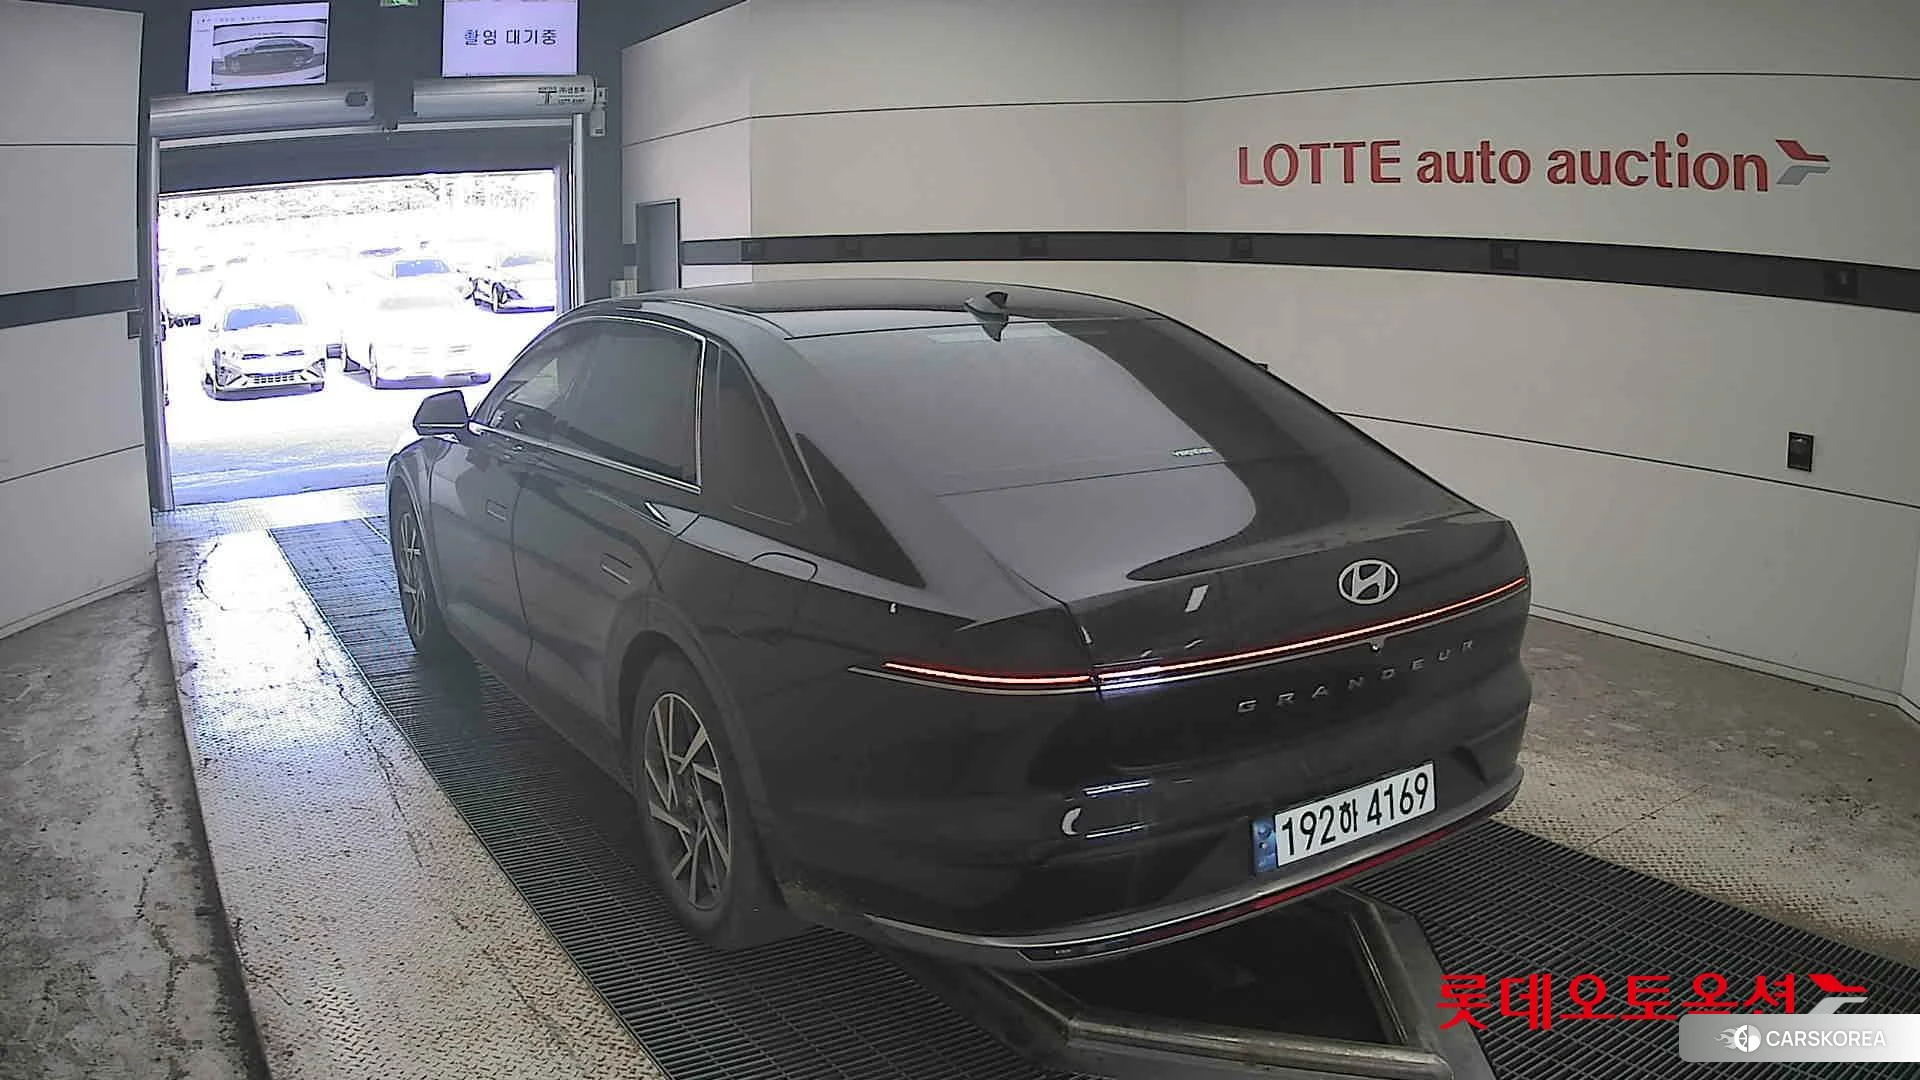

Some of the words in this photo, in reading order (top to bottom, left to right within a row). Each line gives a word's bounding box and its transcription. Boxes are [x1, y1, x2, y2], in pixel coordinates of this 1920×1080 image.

[464, 29, 497, 46] 촬영
[505, 28, 557, 46] 대기중
[1237, 138, 1401, 187] LOTTE
[1416, 139, 1532, 186] auto
[1546, 131, 1770, 193] auction
[1237, 639, 1476, 714] GRANDEUR
[1281, 799, 1359, 857] 192하
[1366, 772, 1429, 827] 4169
